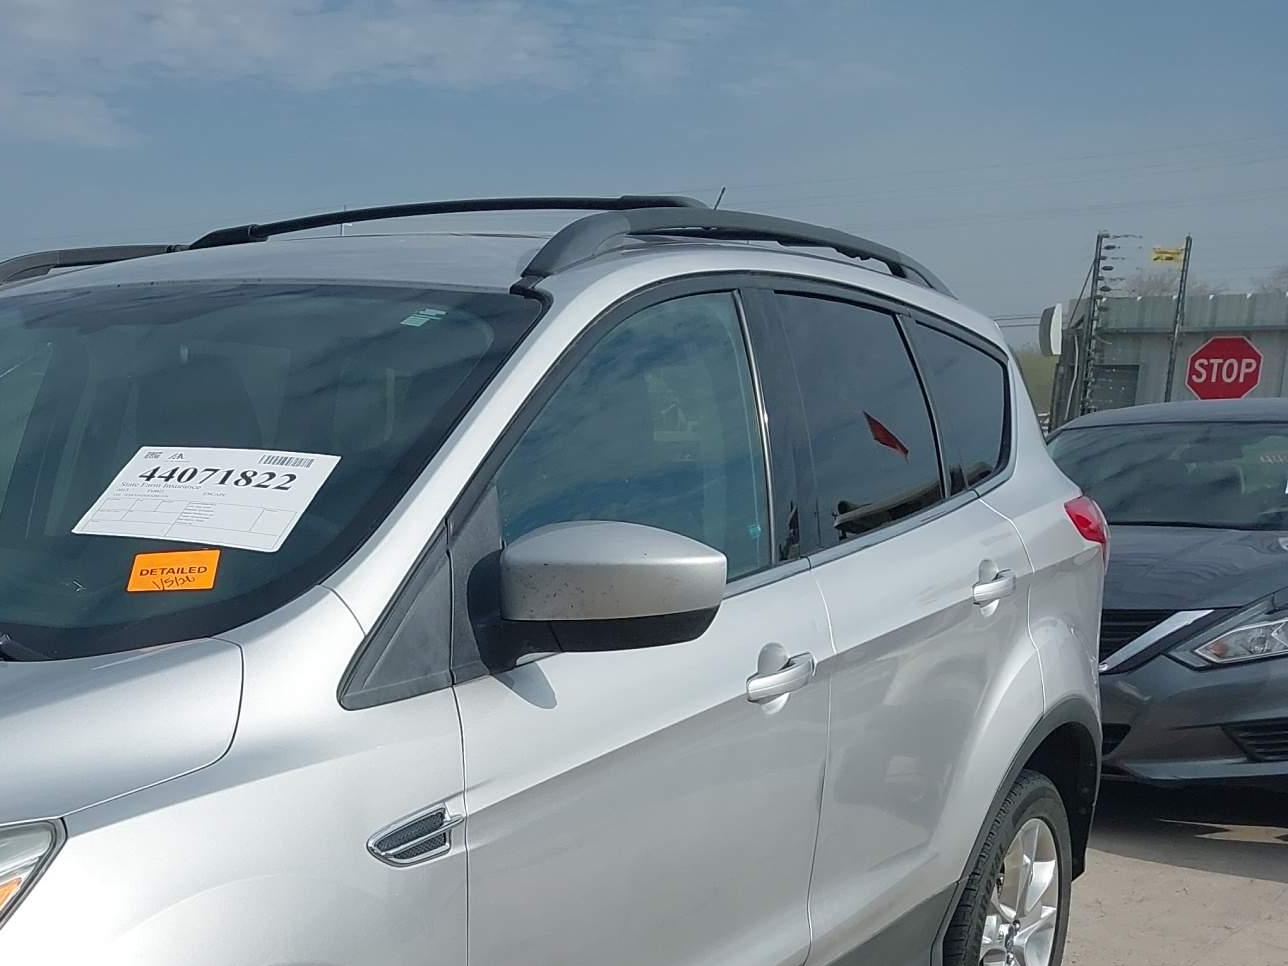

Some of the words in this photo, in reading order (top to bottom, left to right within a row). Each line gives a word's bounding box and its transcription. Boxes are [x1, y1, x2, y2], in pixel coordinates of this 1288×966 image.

[1192, 358, 1257, 383] STOP
[138, 465, 297, 491] 44071822
[163, 482, 202, 490] Insurance
[139, 566, 208, 577] DETAILED
